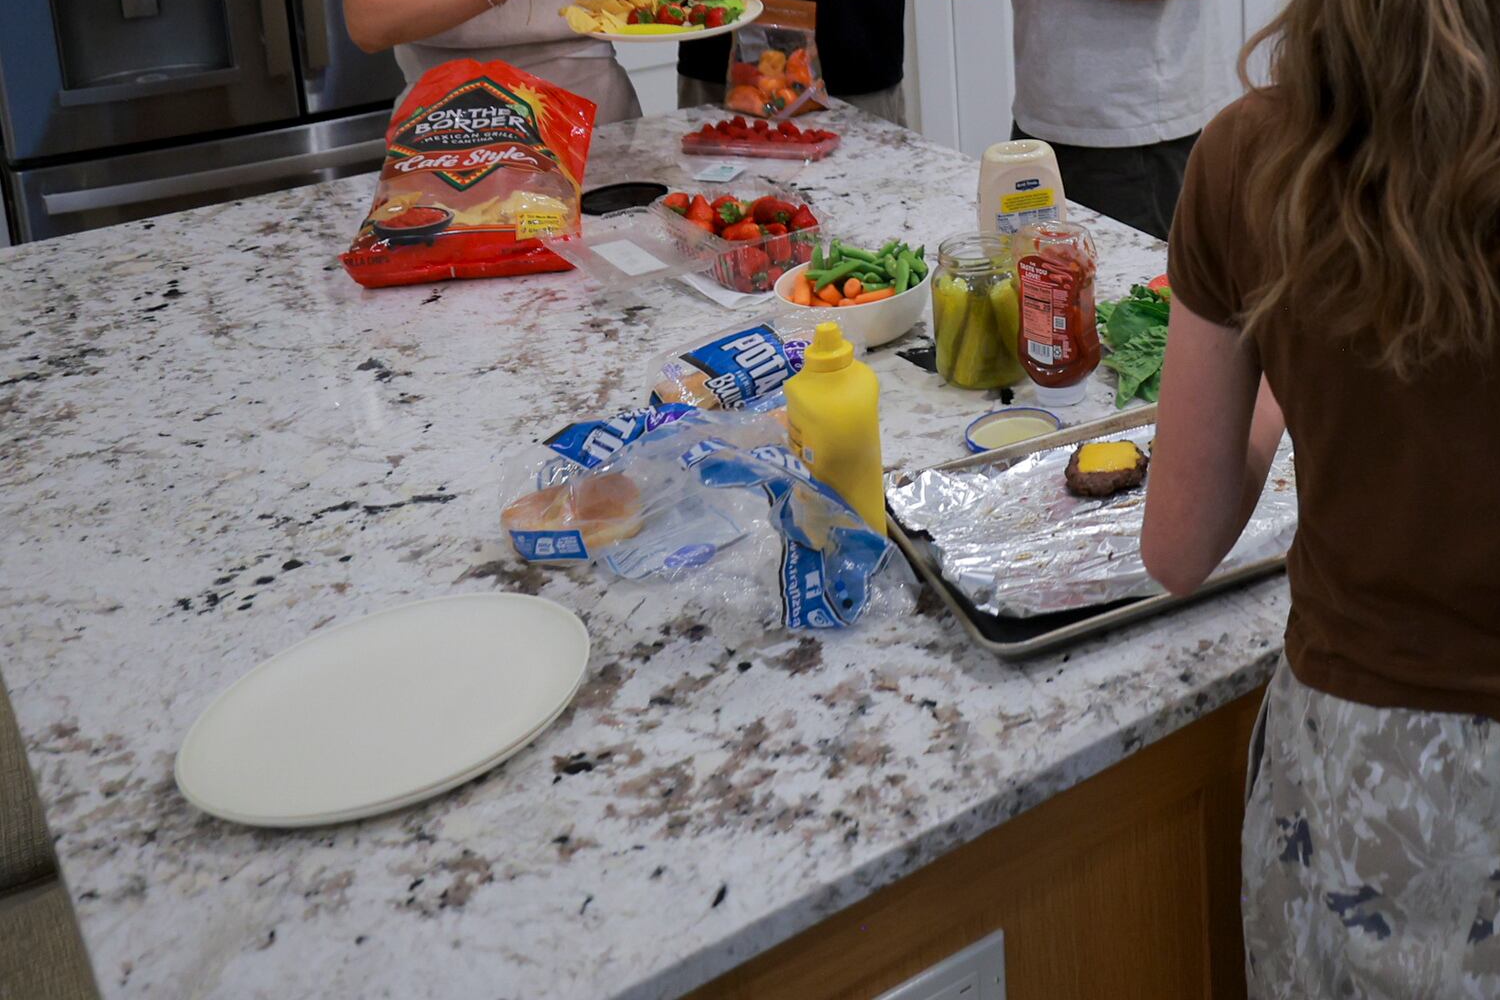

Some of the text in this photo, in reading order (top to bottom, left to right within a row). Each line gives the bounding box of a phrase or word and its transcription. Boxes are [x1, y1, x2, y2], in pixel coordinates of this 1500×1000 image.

[427, 106, 512, 122] ON THE
[414, 116, 530, 137] BORDER
[424, 132, 480, 143] MEXICAN
[394, 145, 539, 173] Café Style
[721, 333, 790, 397] POTA
